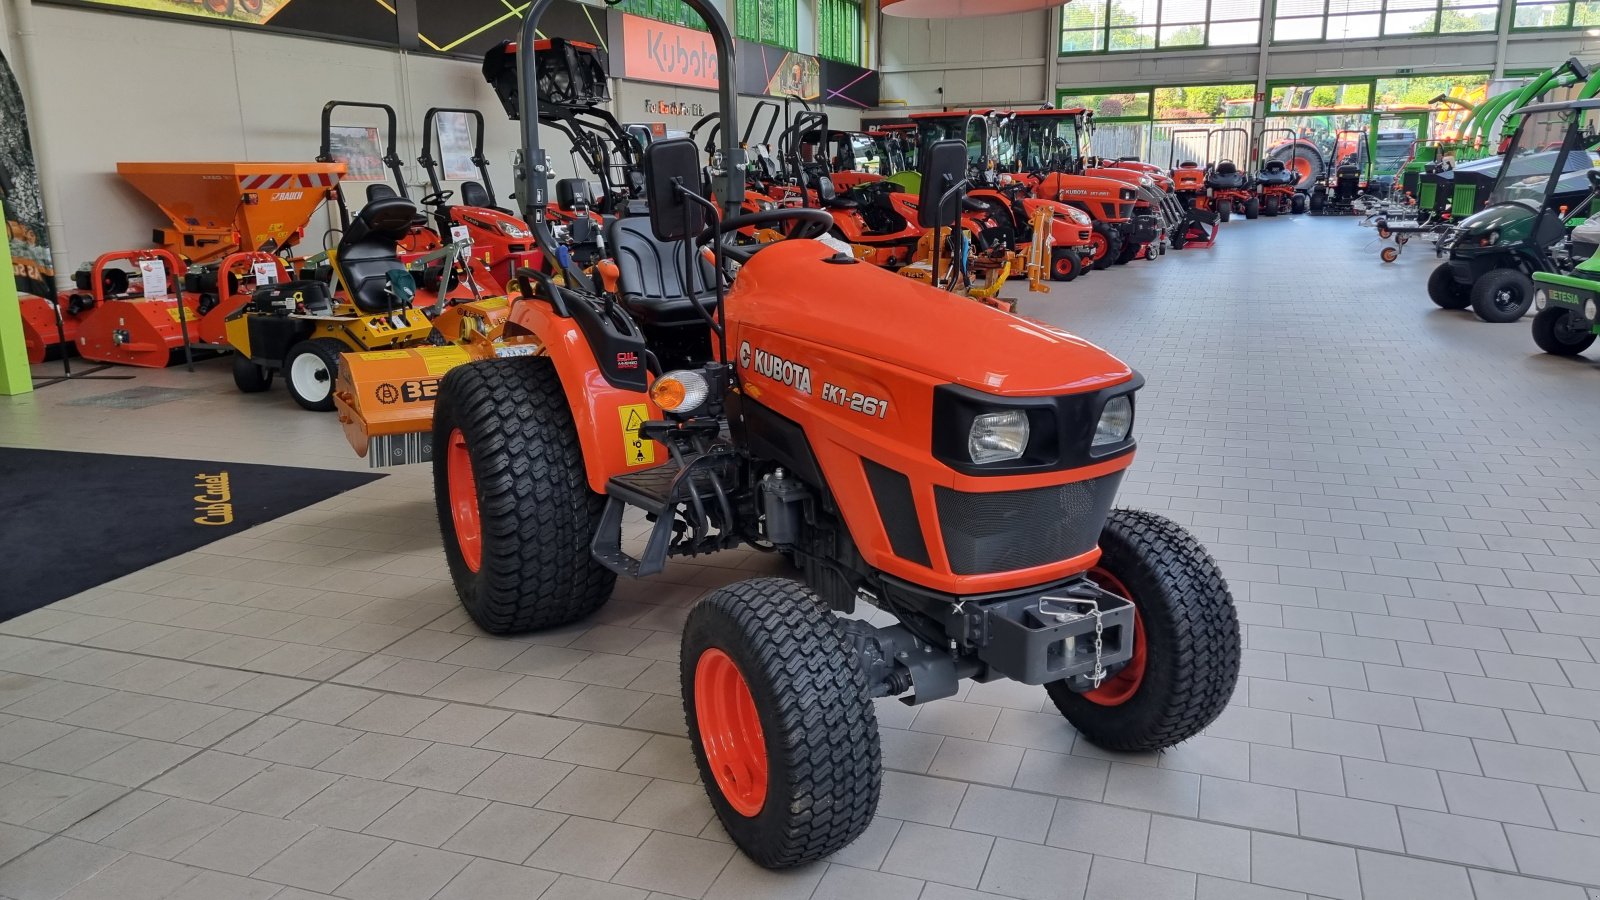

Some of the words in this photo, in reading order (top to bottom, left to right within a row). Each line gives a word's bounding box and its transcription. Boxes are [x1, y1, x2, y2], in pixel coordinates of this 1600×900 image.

[401, 379, 440, 403] BE
[753, 347, 813, 396] KUBOTA
[821, 381, 889, 419] EK1-261
[193, 471, 231, 503] Cadet
[193, 503, 235, 526] Cub
